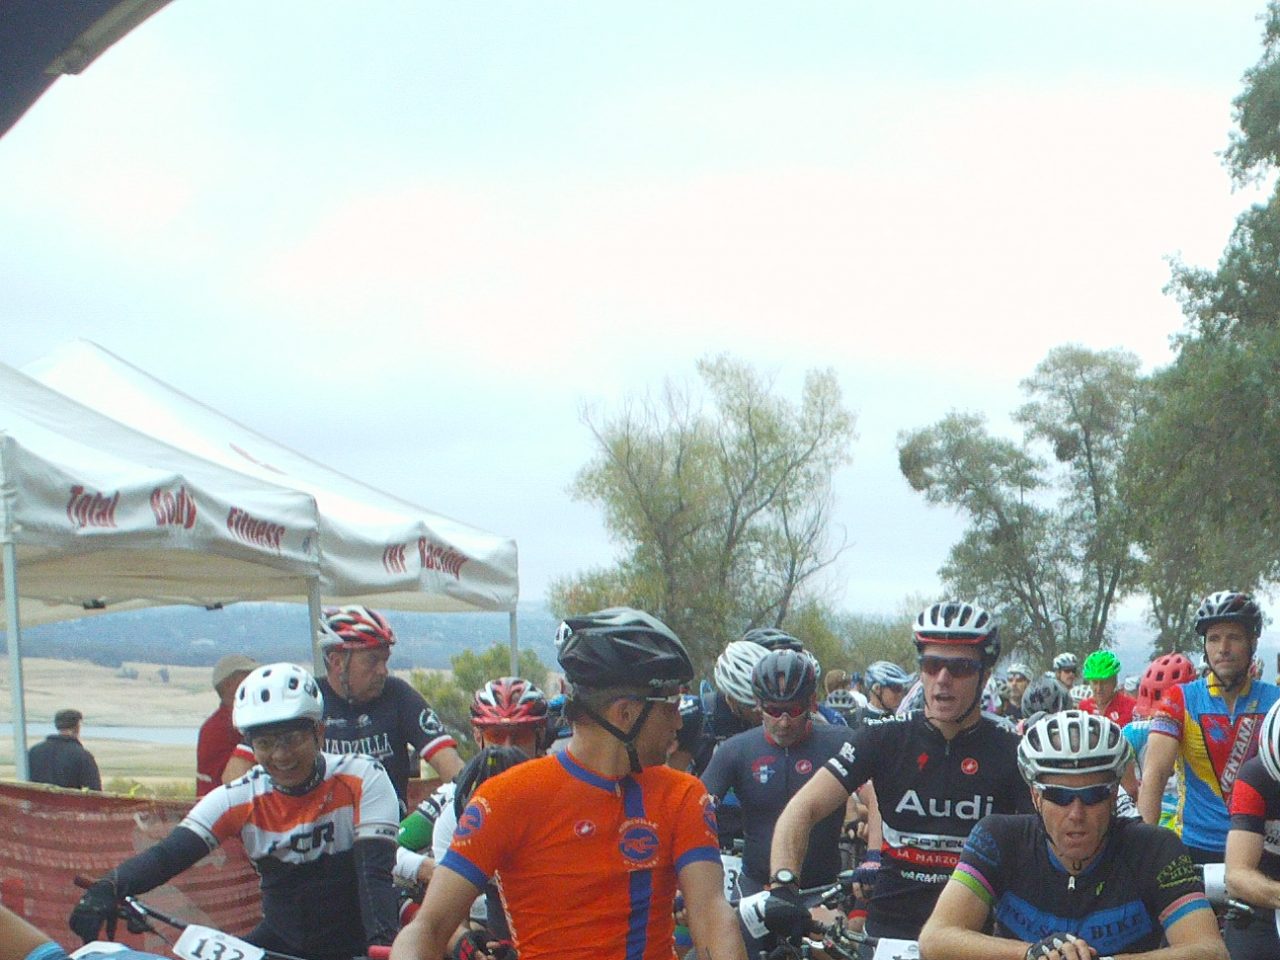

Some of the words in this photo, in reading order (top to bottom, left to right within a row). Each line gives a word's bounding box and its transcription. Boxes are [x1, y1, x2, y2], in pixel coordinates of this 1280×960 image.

[66, 485, 120, 528] Total
[150, 486, 197, 529] Body
[1222, 716, 1254, 793] VENTANA
[895, 789, 994, 820] Audi
[896, 849, 910, 860] LA
[1090, 912, 1143, 941] BIKE
